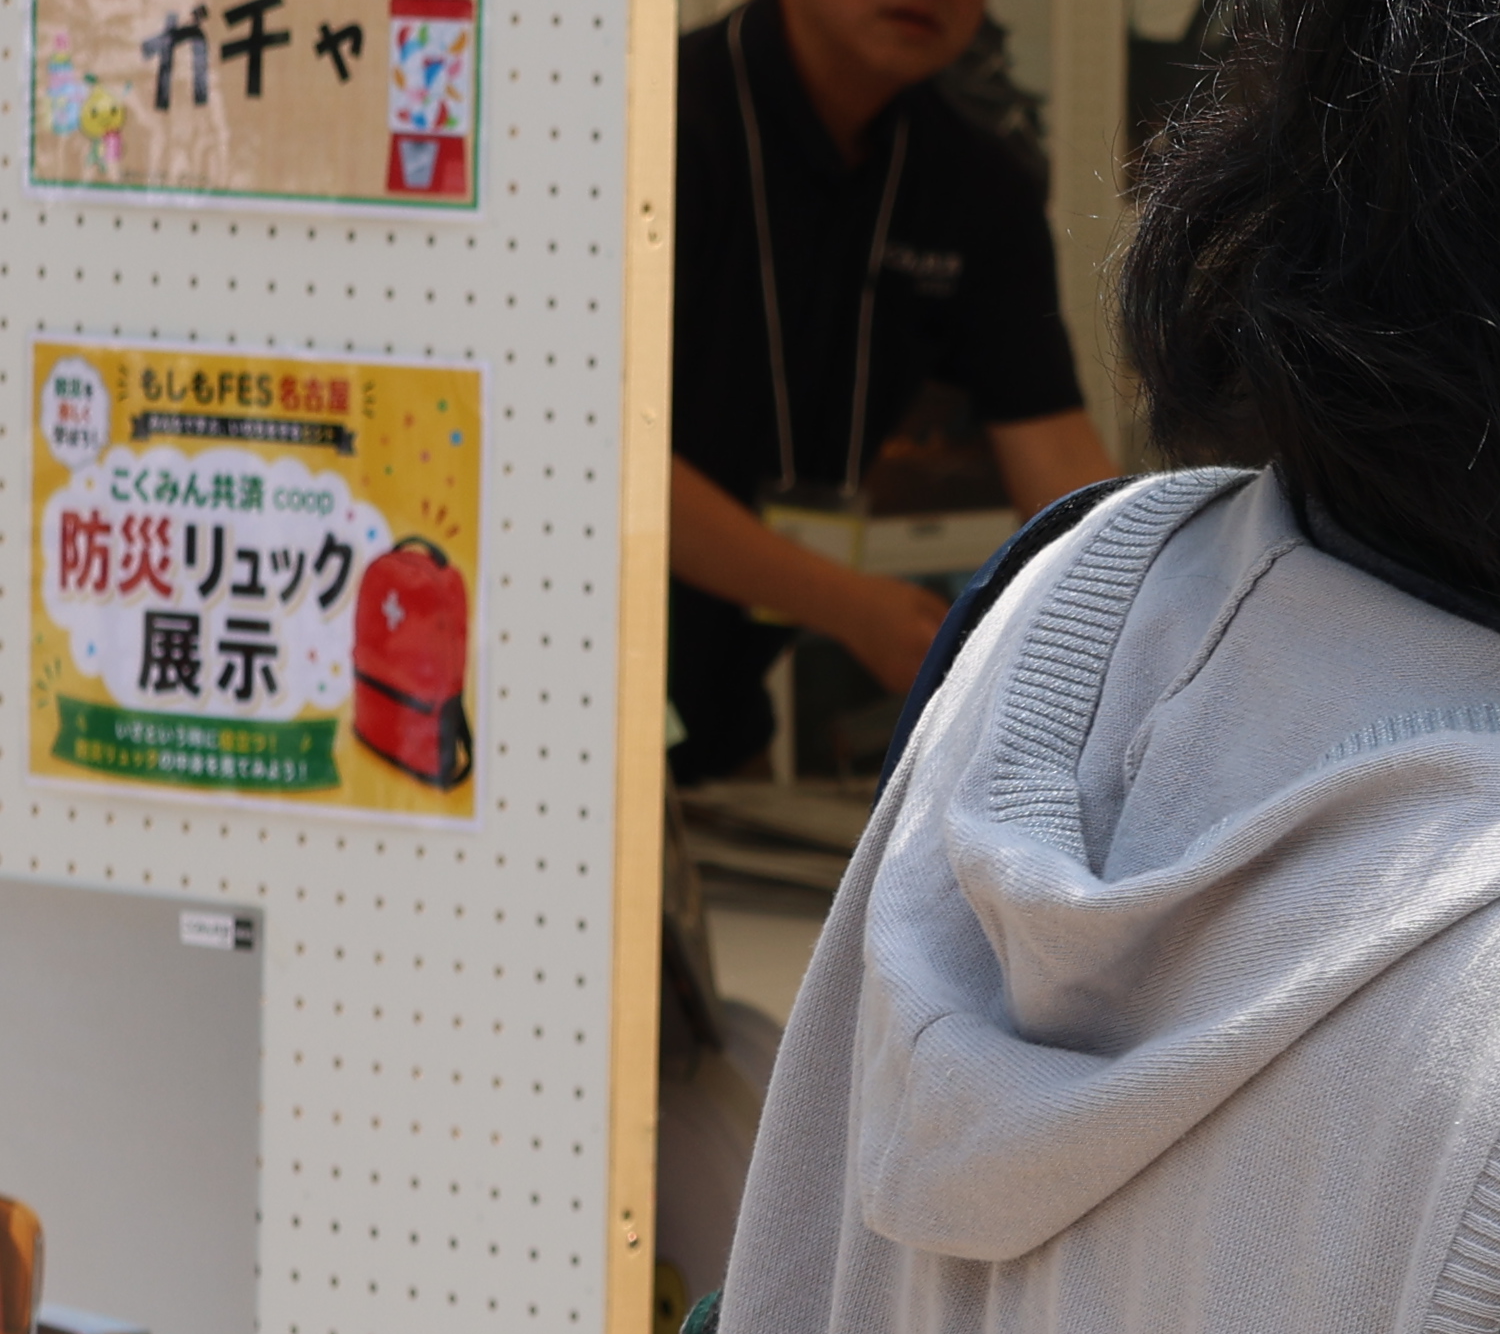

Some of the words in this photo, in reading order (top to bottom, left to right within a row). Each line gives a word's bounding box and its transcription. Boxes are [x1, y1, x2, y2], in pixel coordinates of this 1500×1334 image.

[110, 467, 265, 513] こくみん共済
[272, 485, 335, 517] coop
[58, 511, 353, 610] 防災リュック
[138, 610, 279, 702] 展示
